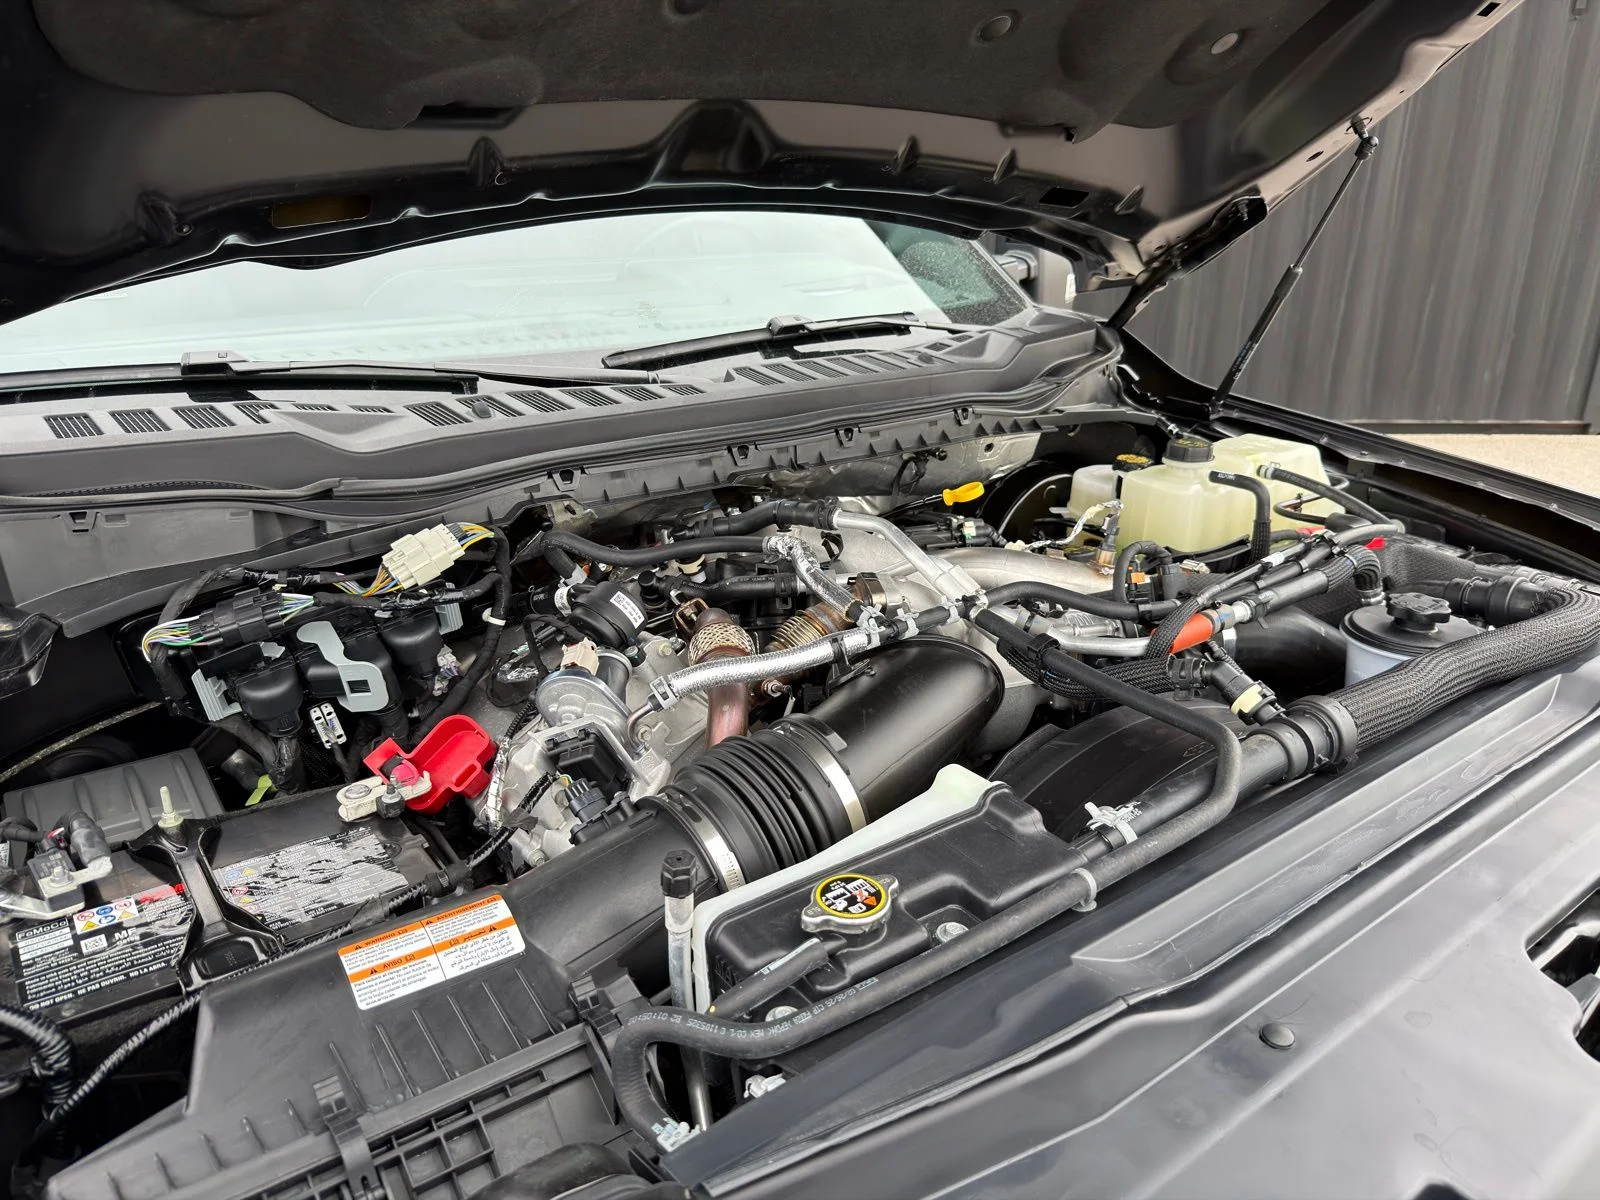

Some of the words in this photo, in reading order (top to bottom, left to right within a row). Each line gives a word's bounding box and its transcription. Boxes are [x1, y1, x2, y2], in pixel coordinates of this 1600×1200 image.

[17, 919, 66, 939] FoMoCo
[114, 926, 137, 940] MF
[382, 958, 402, 969] AVISO
